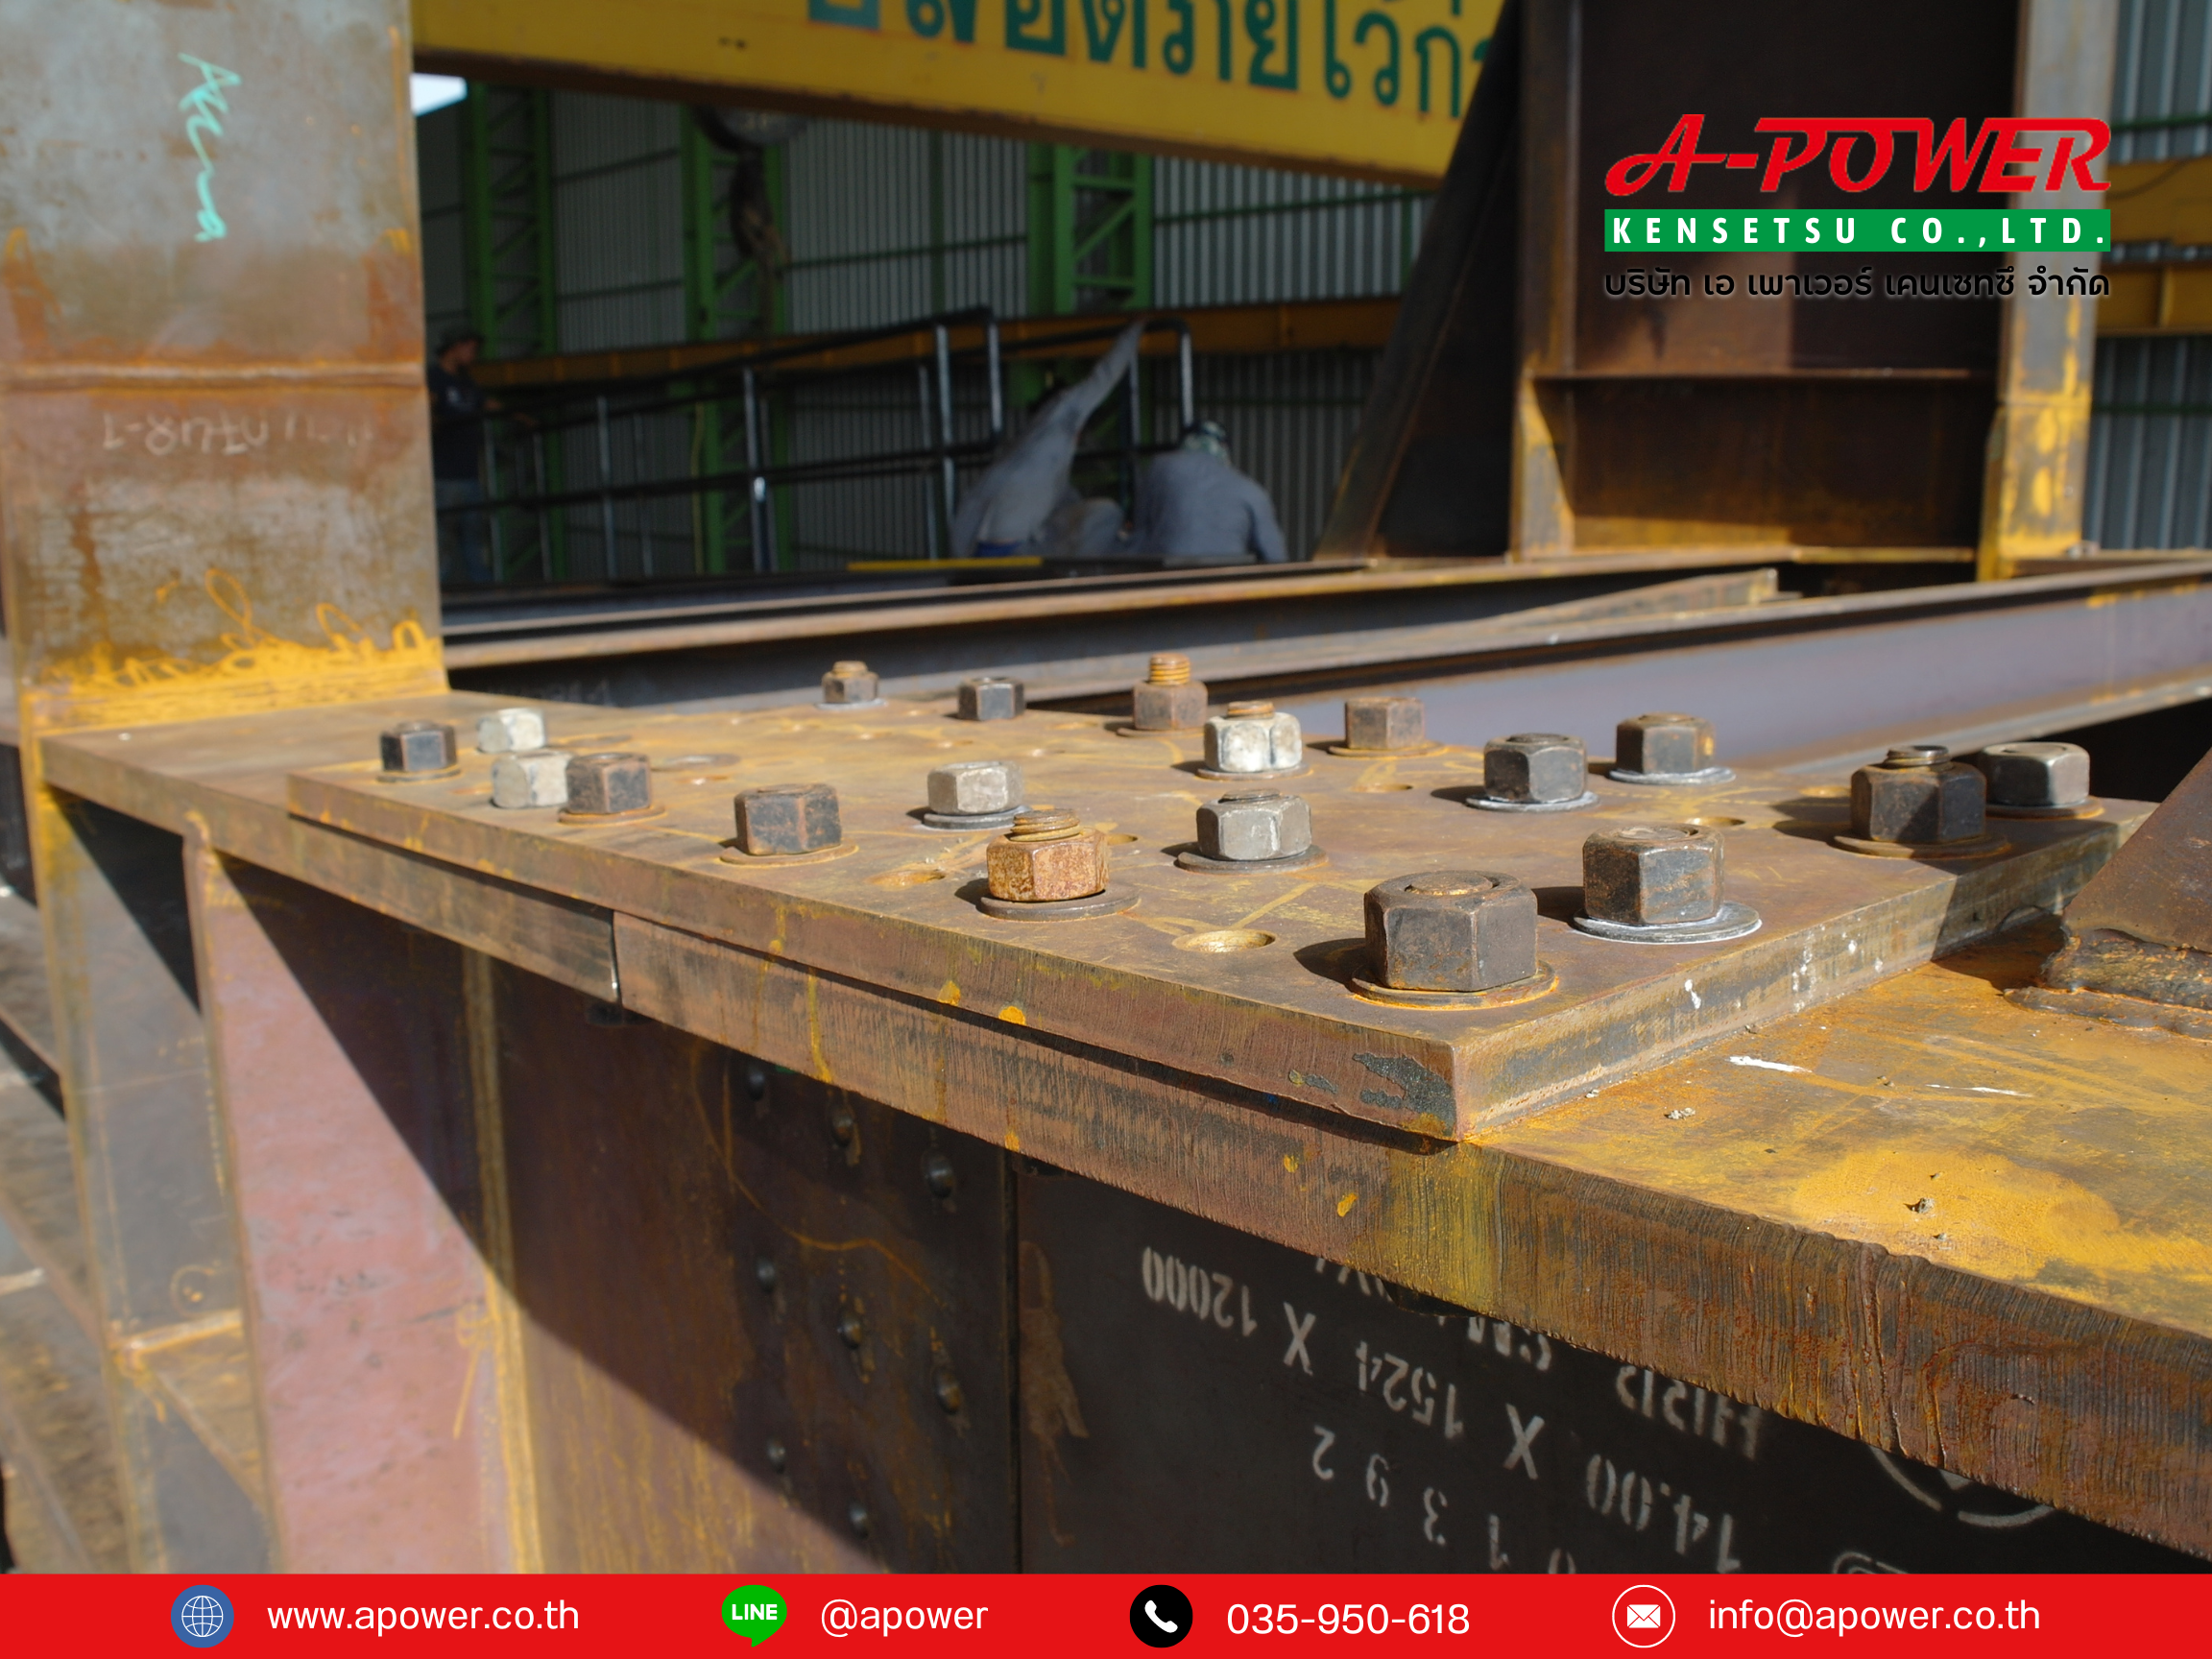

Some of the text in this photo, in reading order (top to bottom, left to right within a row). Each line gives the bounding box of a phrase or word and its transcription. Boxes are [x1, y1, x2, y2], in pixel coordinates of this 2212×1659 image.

[1142, 1247, 1258, 1337] 12000
[1282, 1301, 1316, 1377] X
[1355, 1340, 1464, 1440] 1524
[1503, 1402, 1545, 1479] X
[1586, 1454, 1741, 1575] 14.00
